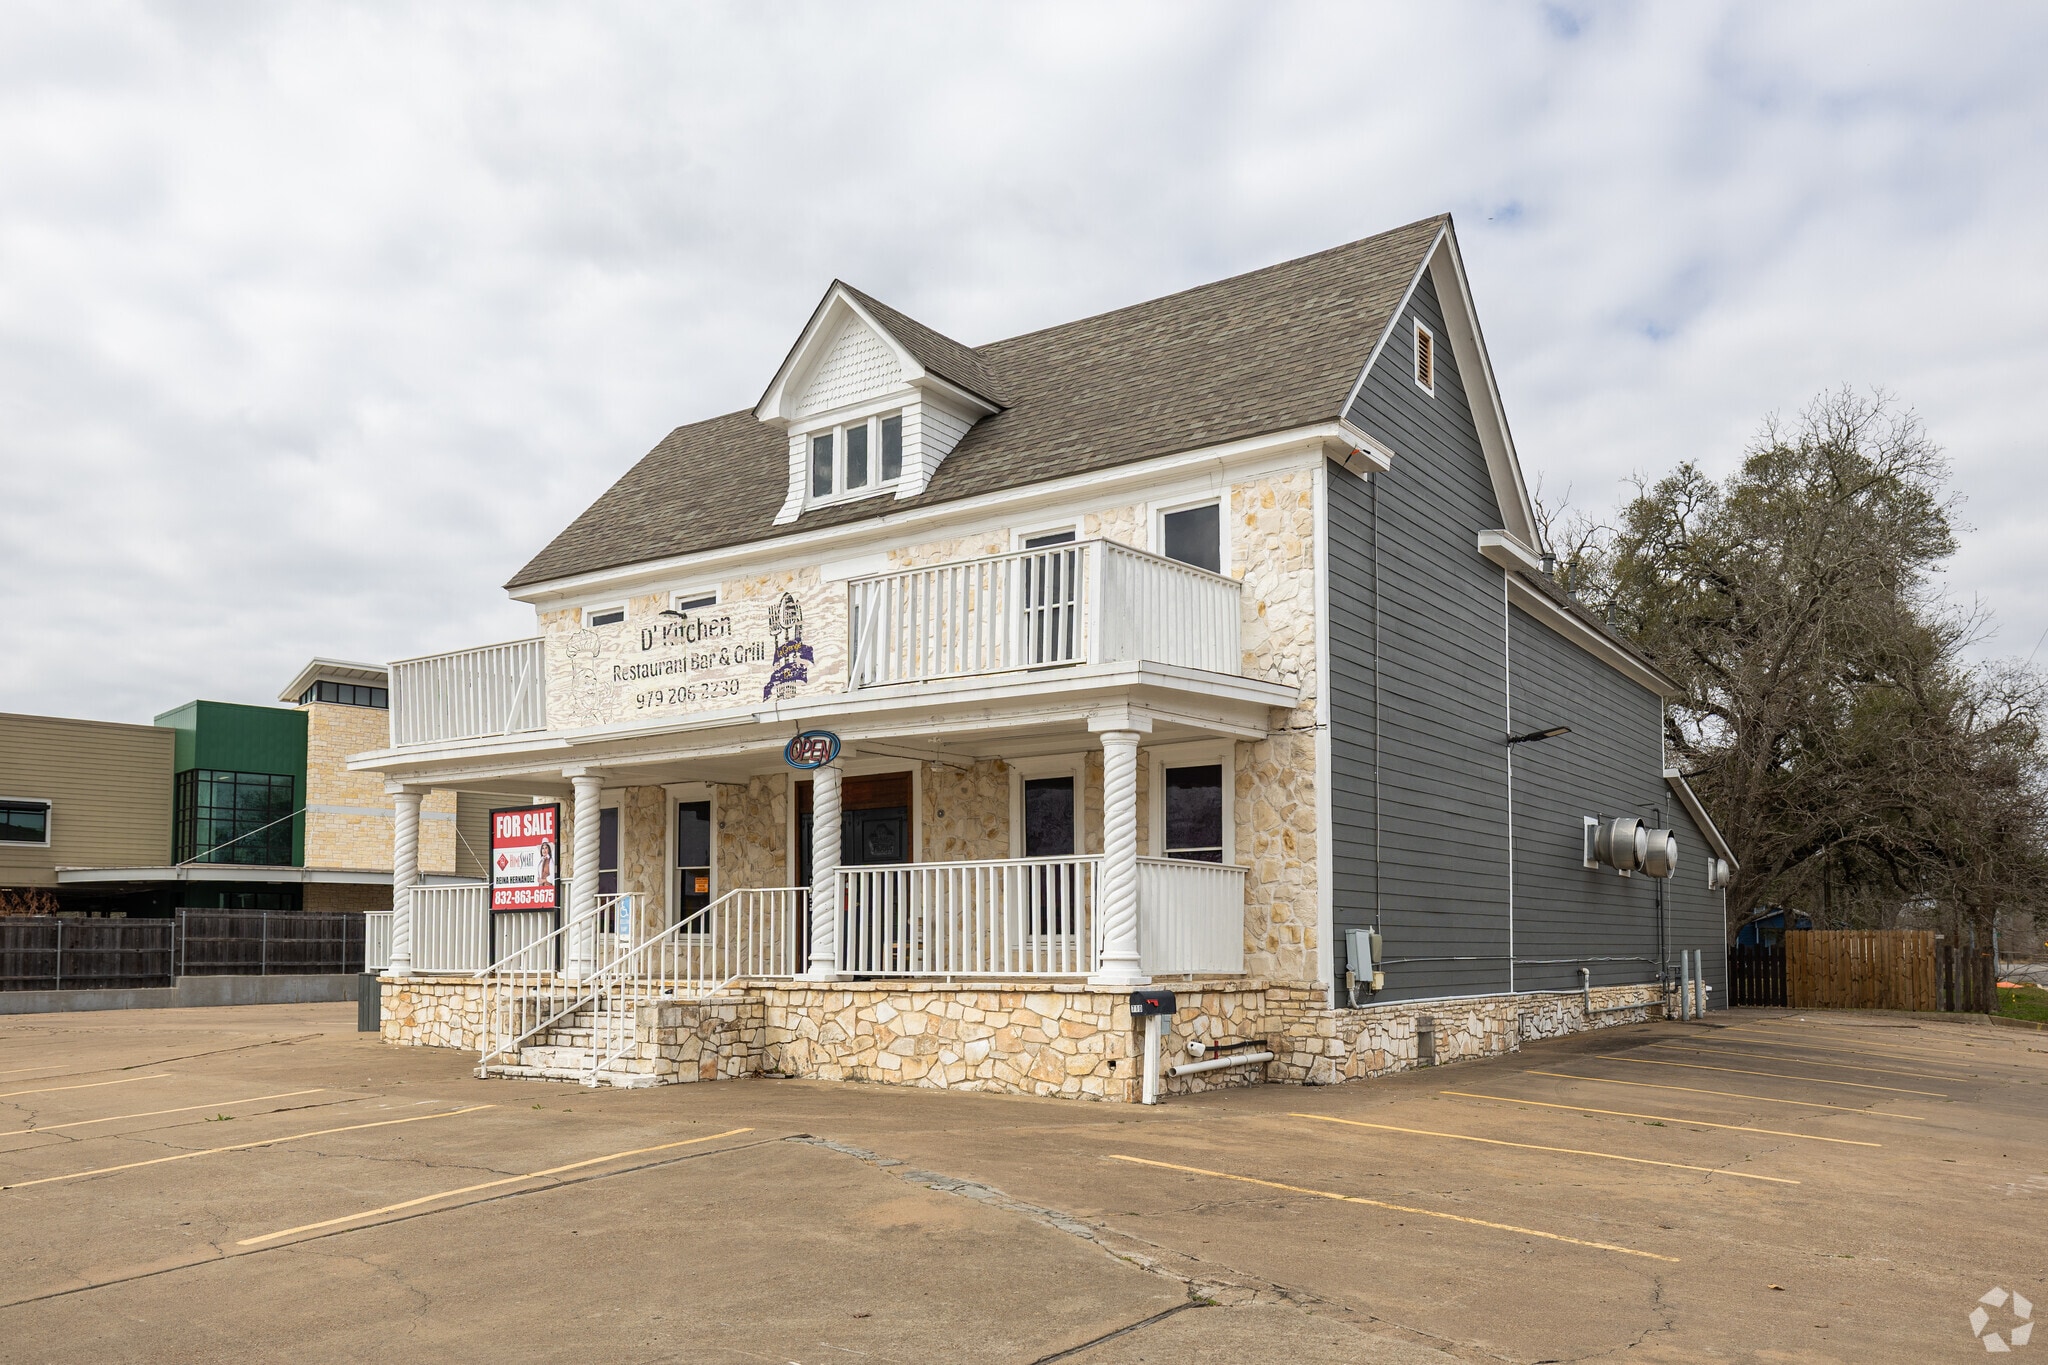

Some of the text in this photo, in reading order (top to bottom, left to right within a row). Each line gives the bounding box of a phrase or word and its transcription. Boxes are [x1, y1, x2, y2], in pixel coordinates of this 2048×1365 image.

[641, 616, 732, 651] D' Kitchen
[613, 642, 765, 682] Restaurant Bar & Grill
[636, 678, 740, 710] 979 206 2230
[790, 738, 832, 761] OPEN
[496, 811, 553, 839] FOR SALE
[495, 874, 535, 885] REINA HERNANDEZ
[494, 889, 554, 905] 832-863-6675
